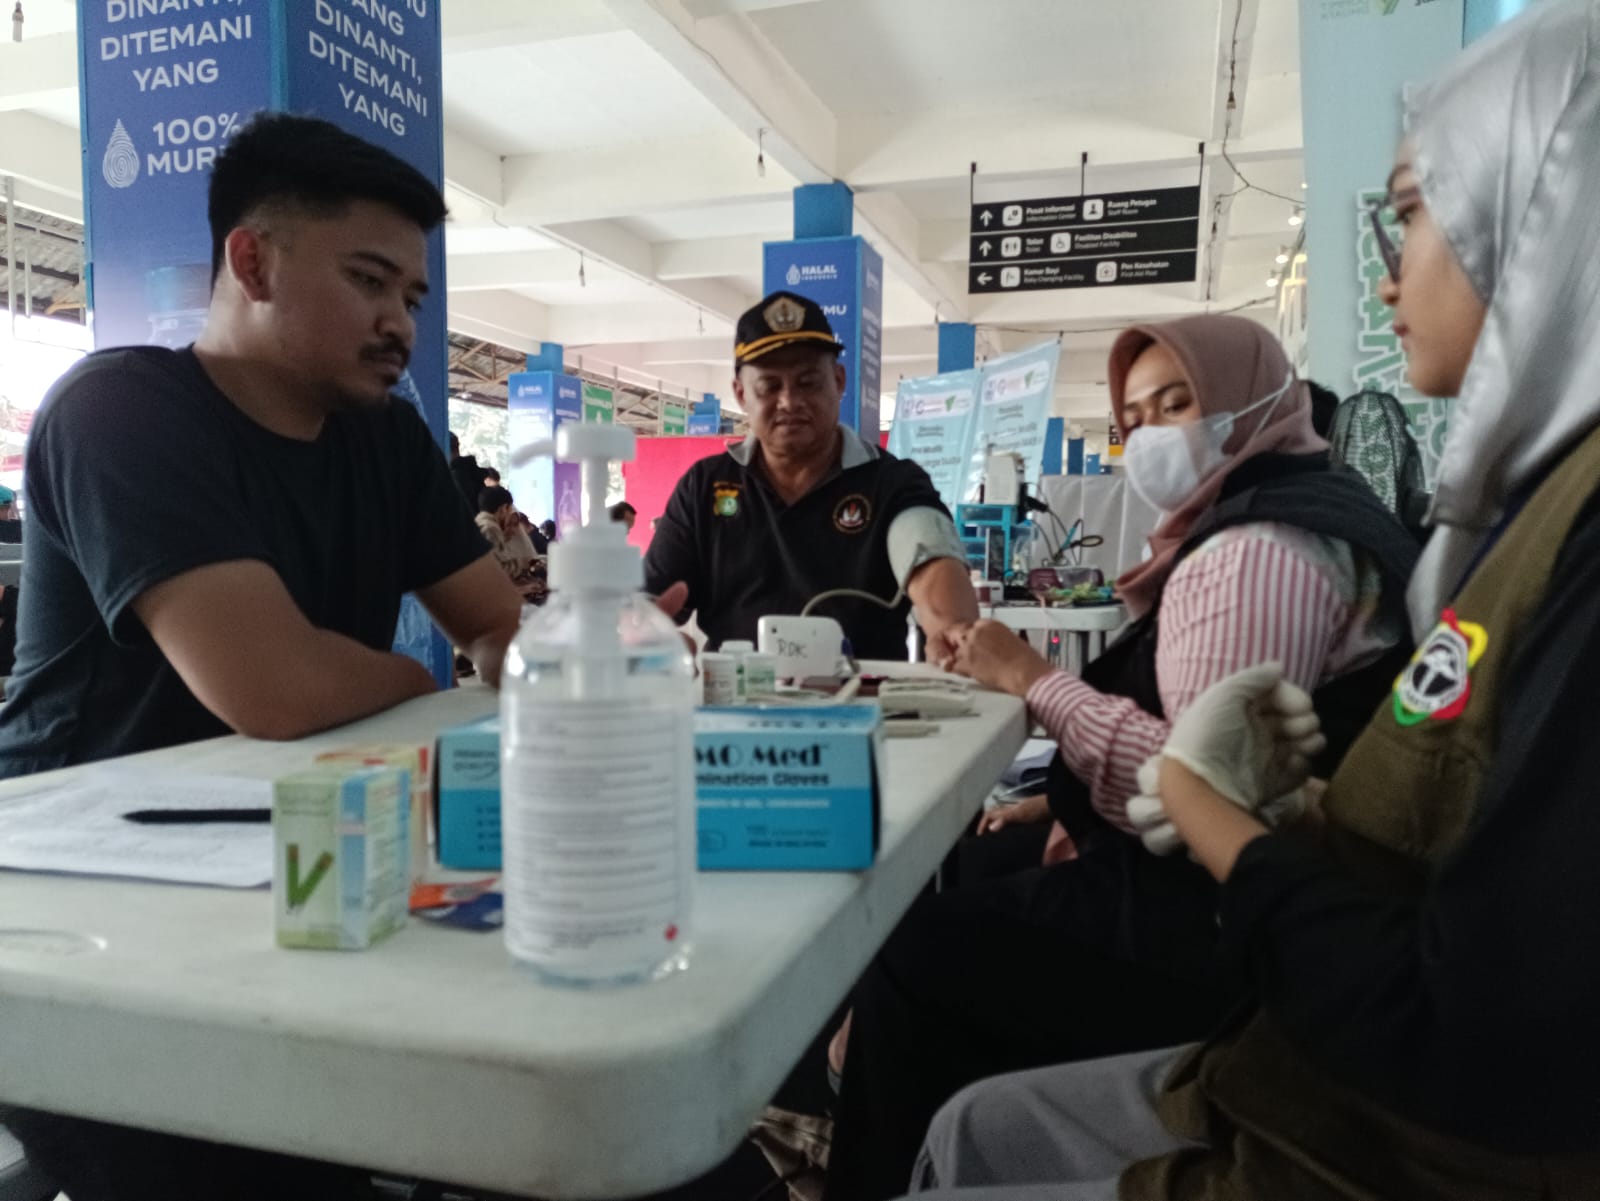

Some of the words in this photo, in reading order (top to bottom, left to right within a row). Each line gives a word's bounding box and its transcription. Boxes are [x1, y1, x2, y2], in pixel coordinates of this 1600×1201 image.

[100, 14, 252, 61] DITEMANI
[315, 1, 423, 84] DINANTI,
[132, 58, 219, 92] YANG
[308, 31, 428, 117] DITEMANI
[338, 83, 406, 136] YANG
[152, 112, 242, 147] 100%
[147, 145, 225, 177] MUR
[801, 264, 838, 275] HALAL
[749, 742, 822, 767] Med
[772, 771, 830, 785] Gloves
